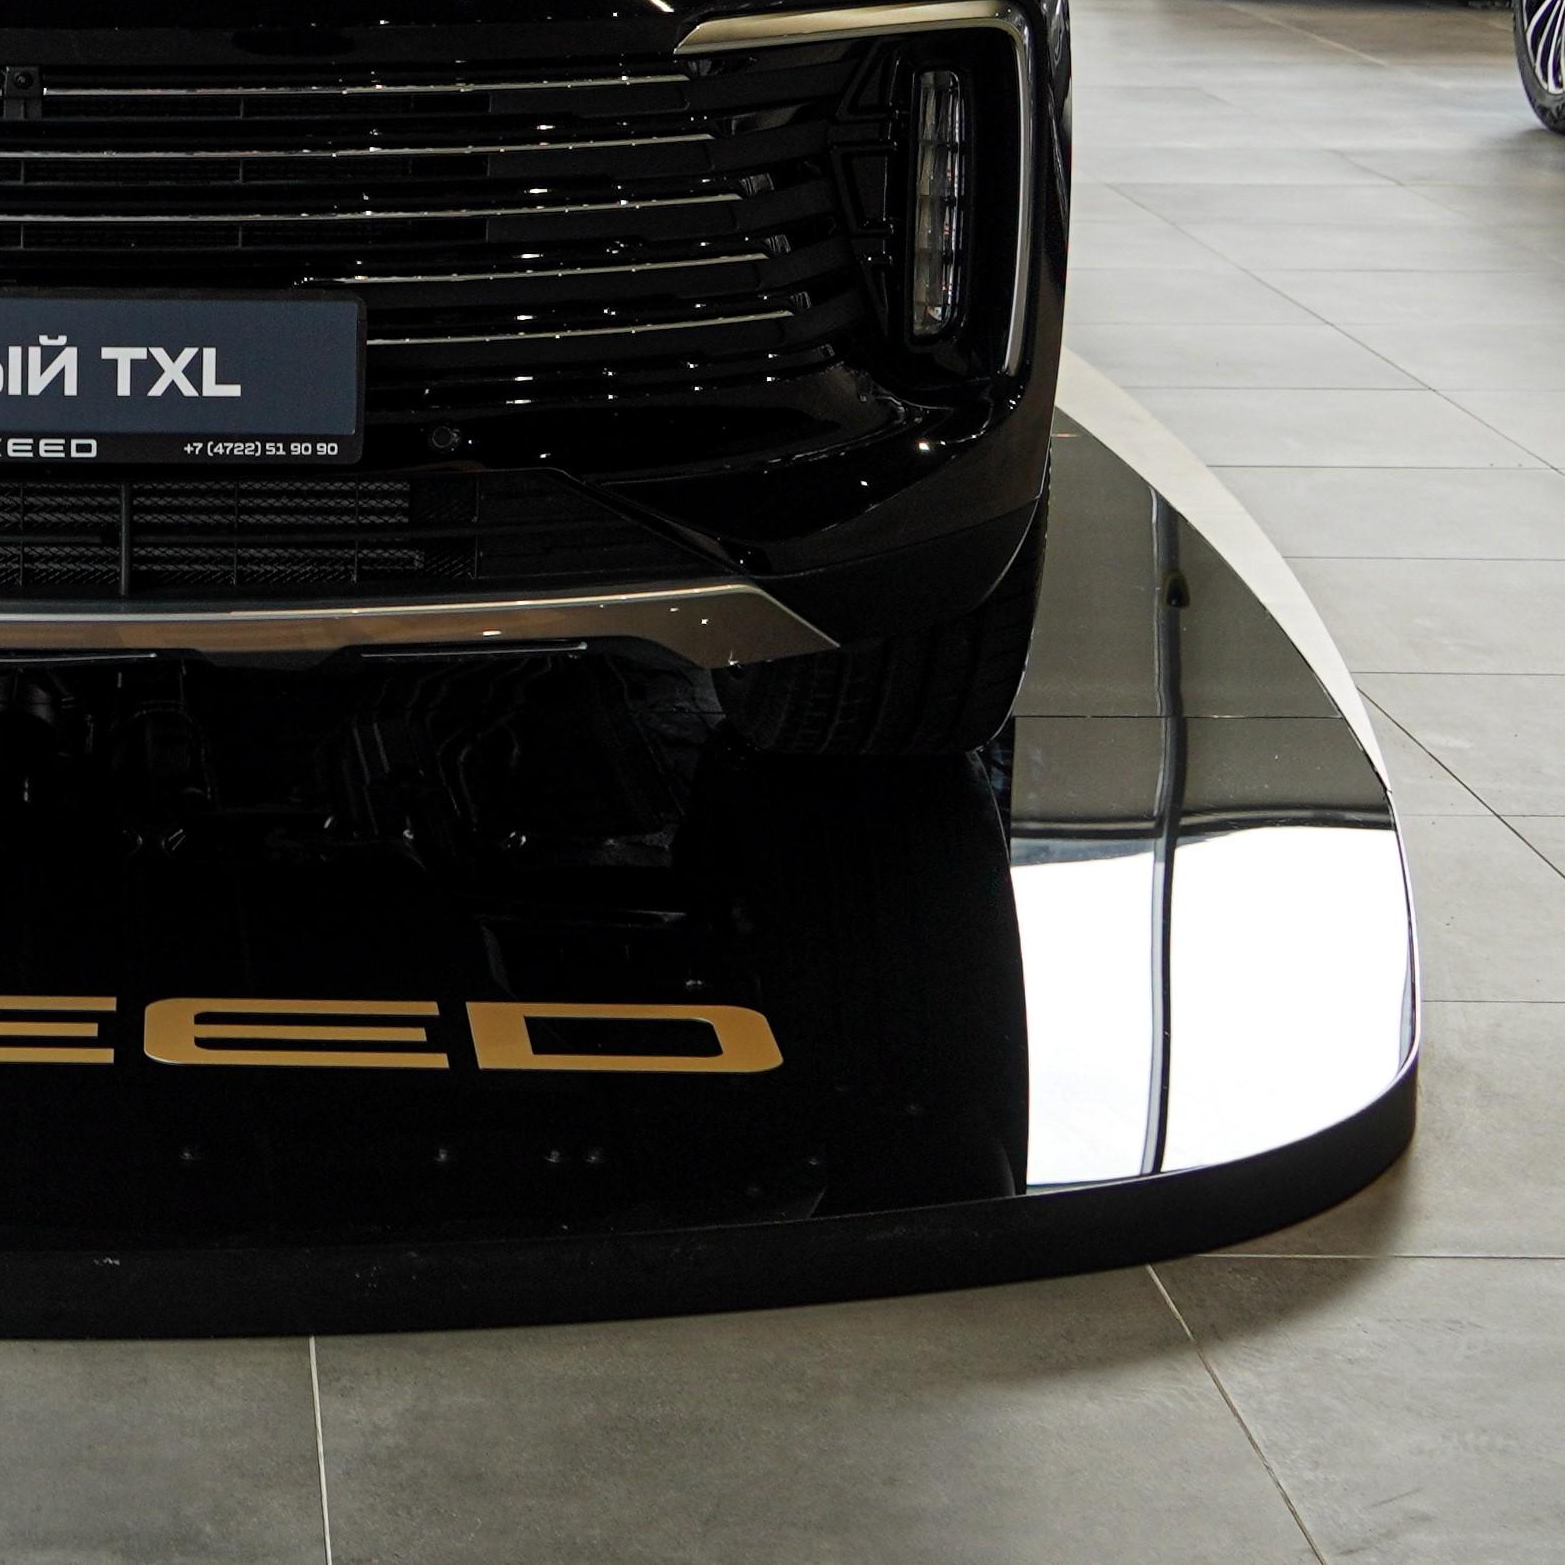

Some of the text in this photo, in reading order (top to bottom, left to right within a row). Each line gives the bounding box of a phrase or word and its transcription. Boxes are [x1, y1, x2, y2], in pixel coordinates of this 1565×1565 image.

[100, 346, 242, 397] TXL
[183, 441, 339, 459] +7 (4722) 51 90 90
